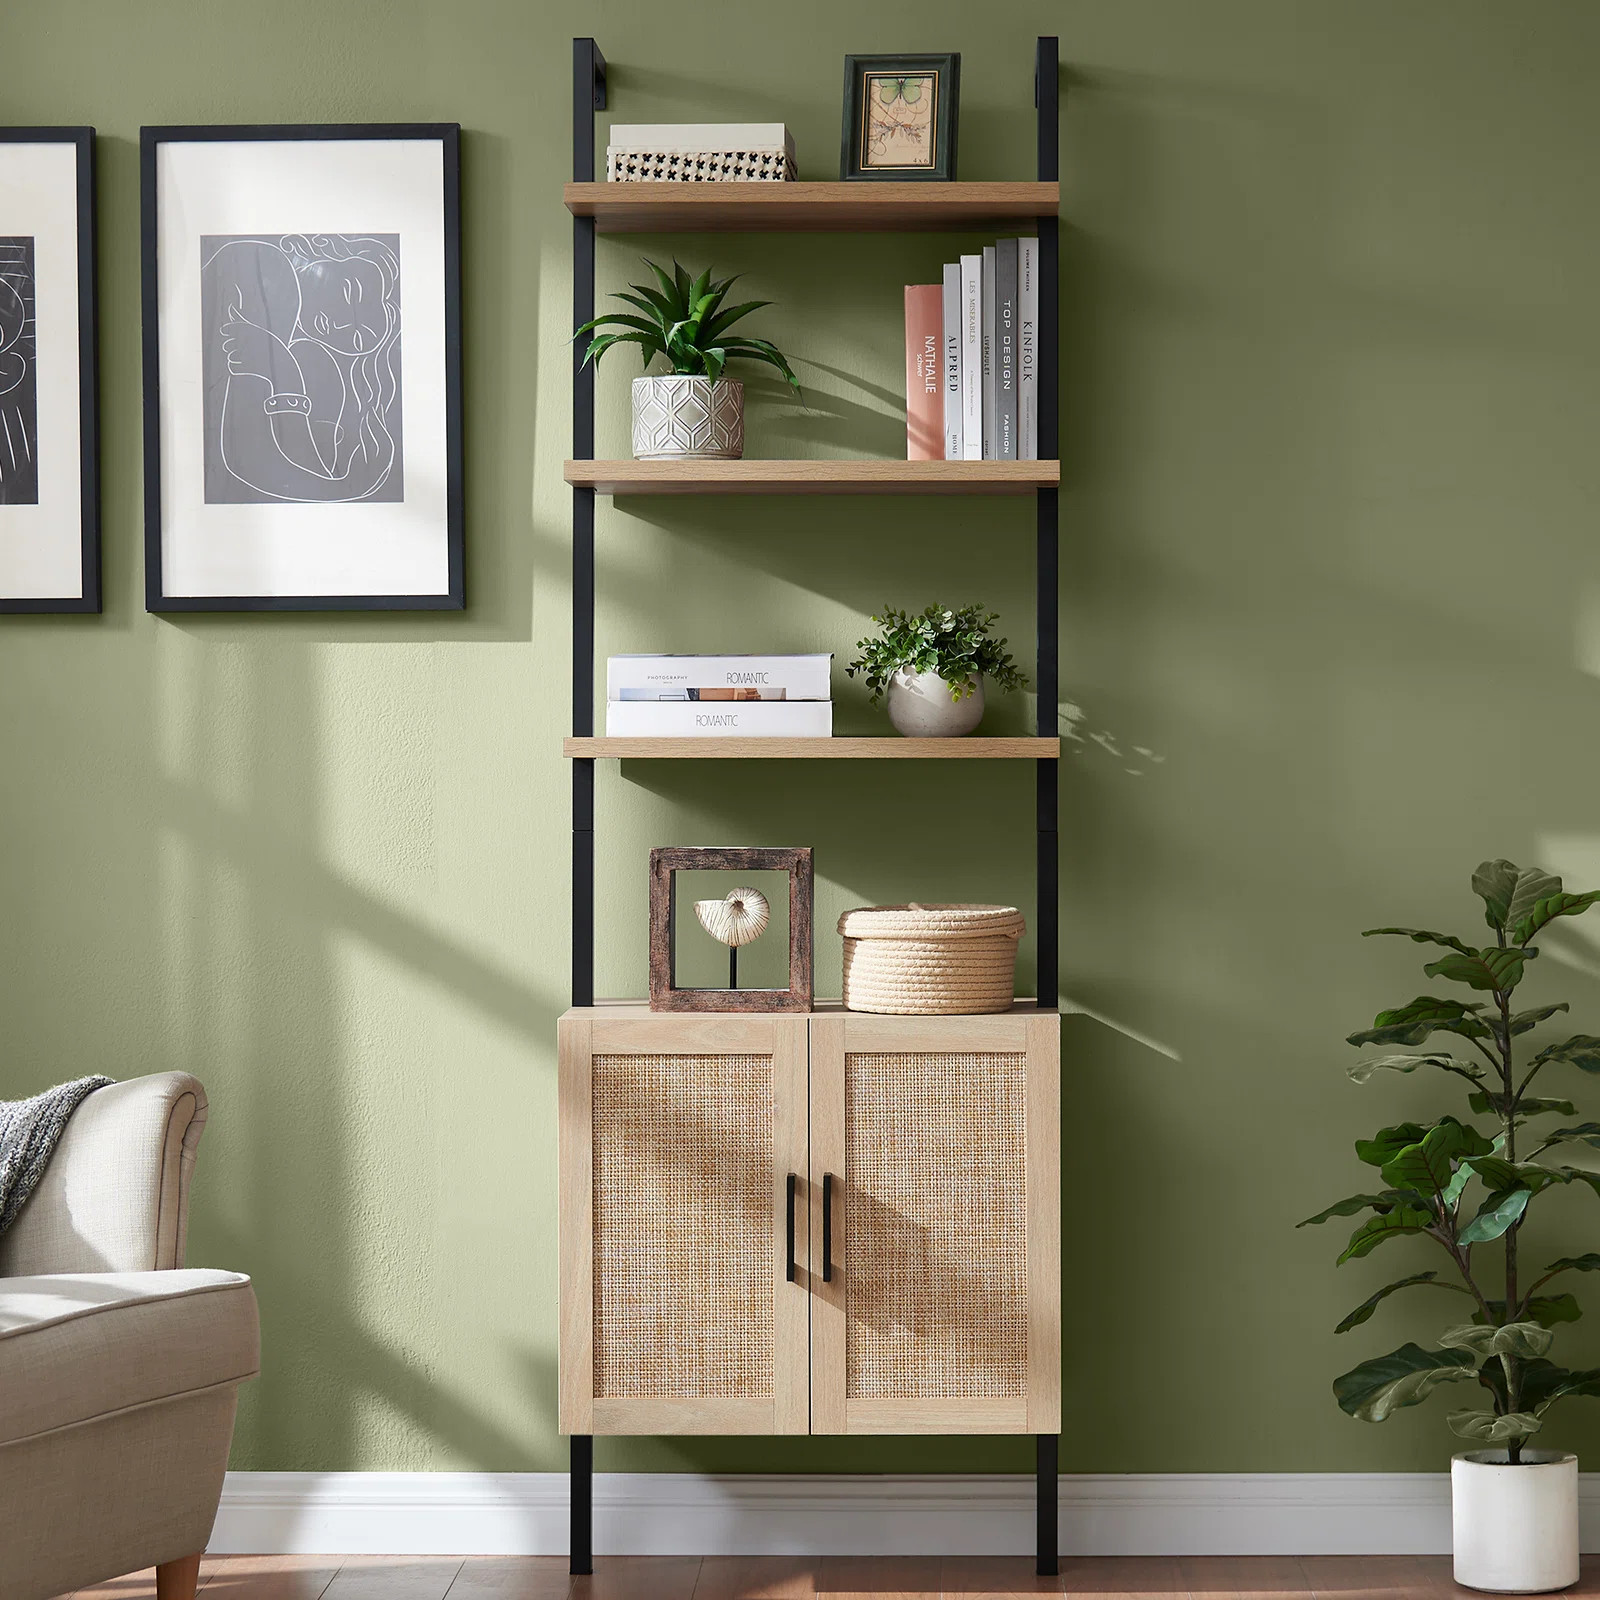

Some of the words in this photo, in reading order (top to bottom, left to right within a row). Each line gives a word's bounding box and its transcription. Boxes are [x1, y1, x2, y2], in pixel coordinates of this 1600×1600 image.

[1003, 300, 1011, 328] TOP
[924, 336, 936, 394] NATHALIE
[948, 336, 958, 392] ALPRED
[1003, 336, 1011, 390] DESIGN
[1023, 321, 1033, 381] KINFOLK
[726, 672, 769, 684] ROMANTIC
[696, 714, 738, 727] ROMANTIC
